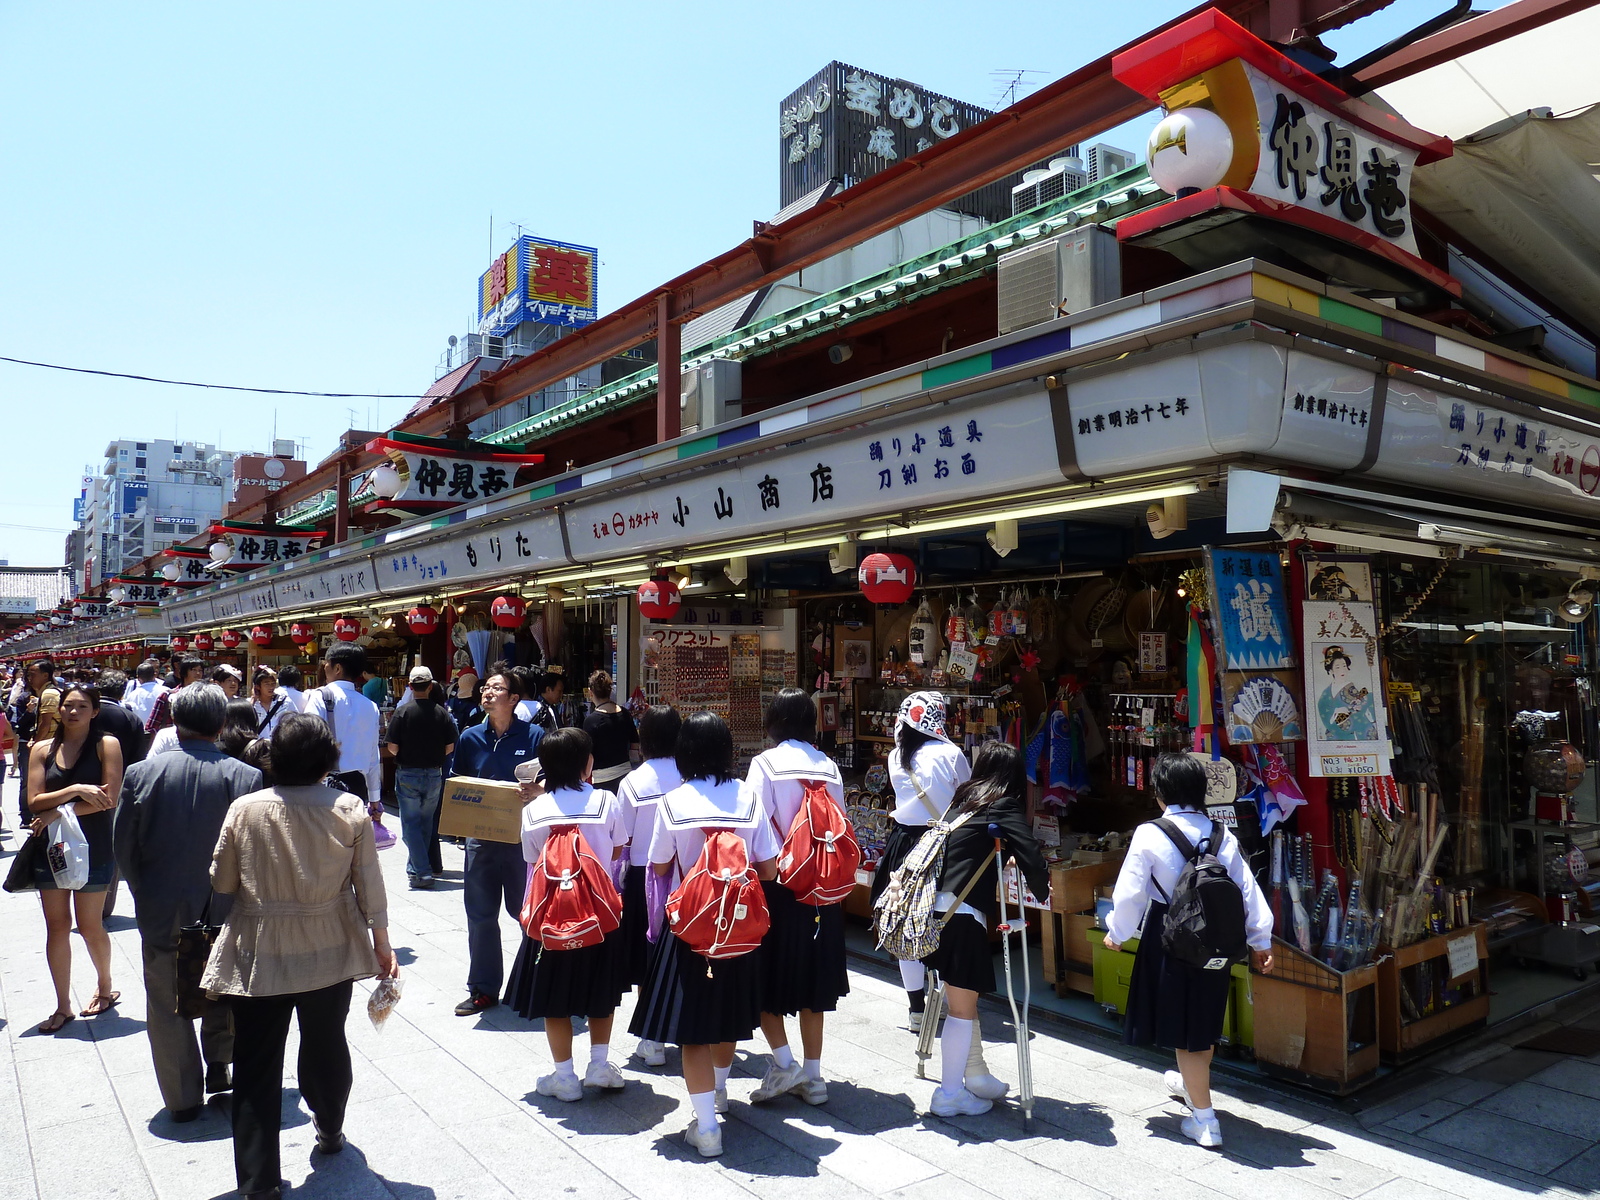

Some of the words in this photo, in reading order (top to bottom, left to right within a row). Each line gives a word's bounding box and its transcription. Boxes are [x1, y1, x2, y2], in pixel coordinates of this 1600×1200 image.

[1269, 93, 1407, 238] 仲見世
[534, 247, 589, 302] 薬
[1077, 397, 1190, 435] 創業明治十七年
[1294, 392, 1368, 428] 創業明治十七年
[1449, 402, 1549, 454] 踊り小道具
[869, 419, 983, 463] 踊り小道具
[415, 458, 510, 499] 仲見世
[877, 452, 977, 491] 刀剣お面
[1551, 452, 1574, 476] 元祖
[592, 523, 610, 539] 元祖
[628, 510, 659, 530] カタナヤ
[672, 463, 835, 528] 小山商店
[466, 530, 532, 568] もりた
[419, 559, 448, 580] ショール
[684, 608, 765, 626] 小山商店
[652, 630, 721, 646] マグネット
[950, 662, 966, 676] 850
[1348, 766, 1374, 774] ¥1050
[1209, 809, 1236, 826] ¥550
